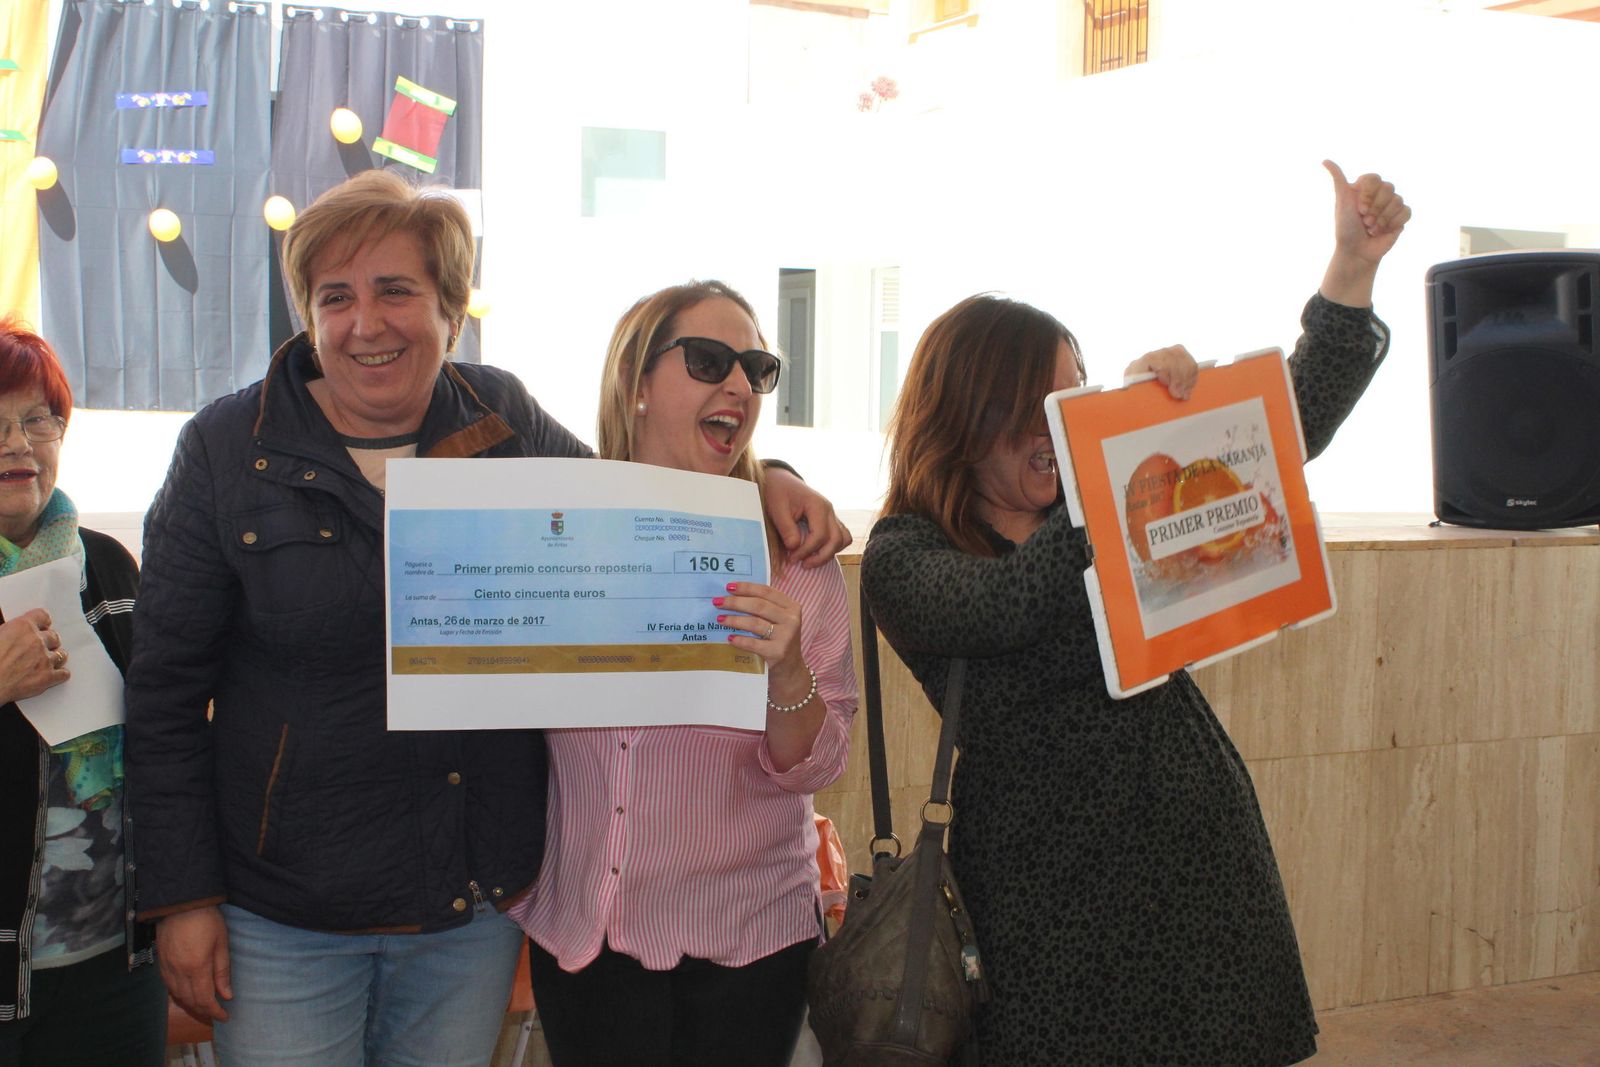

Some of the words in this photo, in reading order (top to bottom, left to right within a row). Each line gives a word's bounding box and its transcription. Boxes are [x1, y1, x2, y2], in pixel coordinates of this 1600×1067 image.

[1139, 468, 1182, 495] FIESTA
[1183, 465, 1199, 481] DE
[1200, 461, 1217, 478] LA
[1216, 444, 1267, 470] NARANJA
[1148, 513, 1205, 546] PRIMER
[1206, 496, 1259, 526] PREMIO
[454, 563, 492, 574] Primer
[495, 564, 535, 576] premio
[537, 564, 591, 574] concurso
[689, 556, 719, 572] 150
[724, 557, 736, 572] €
[474, 588, 511, 599] Ciento
[514, 588, 570, 599] cincuenta
[573, 589, 606, 599] euros
[410, 616, 442, 627] Antas,
[444, 615, 458, 626] 26
[459, 616, 471, 625] de
[473, 618, 504, 626] marzo
[507, 616, 519, 625] de
[522, 616, 545, 625] 2017
[647, 623, 657, 631] IV
[660, 623, 681, 631] Feria
[683, 622, 695, 631] de
[697, 622, 706, 631] la
[682, 633, 708, 641] Antas
